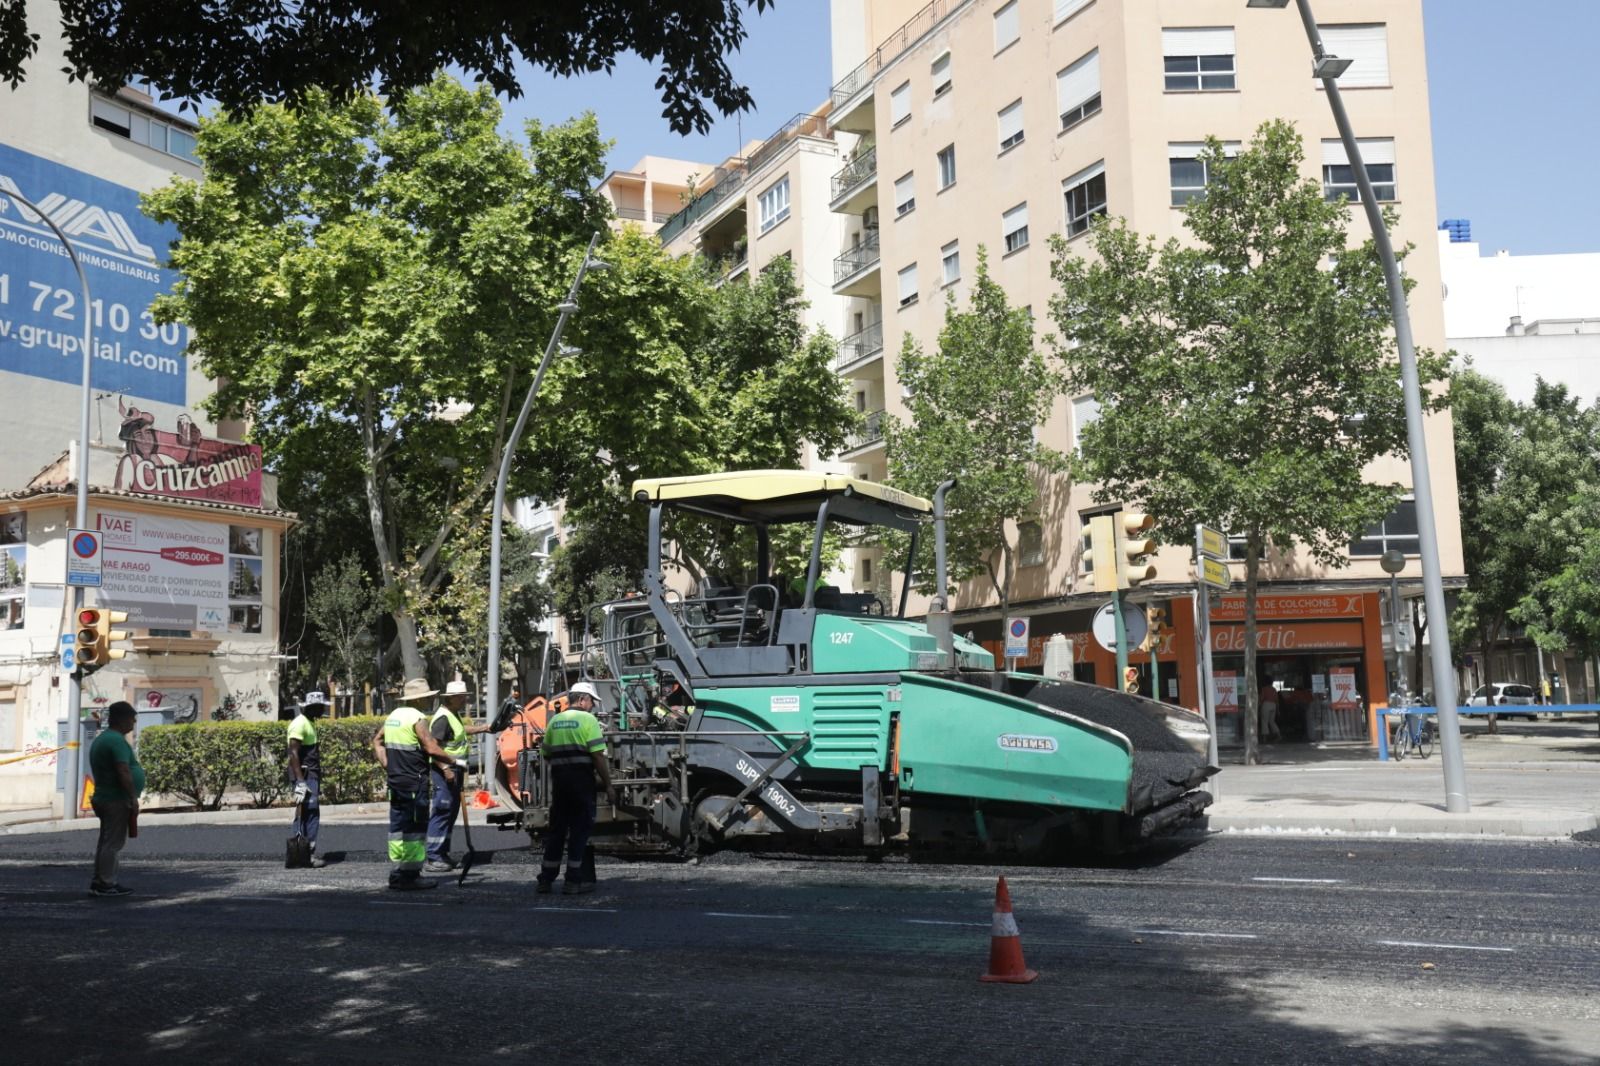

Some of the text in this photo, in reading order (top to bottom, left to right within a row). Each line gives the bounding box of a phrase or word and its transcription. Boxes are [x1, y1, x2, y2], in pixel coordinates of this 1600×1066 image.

[78, 252, 161, 284] INMOBILIARIAS
[29, 281, 75, 321] 72
[91, 298, 130, 333] 10
[136, 452, 259, 492] Cruzcampo
[104, 518, 132, 533] VAE
[142, 529, 225, 546] WWW.VAEHOMES.COM
[103, 560, 119, 570] VAE
[103, 572, 146, 583] VIVIENDAS
[148, 574, 162, 585] DE
[168, 577, 222, 590] DORMITORIOS
[103, 582, 224, 600] ZONA SOLARIUM CON JACUZZI
[1221, 598, 1337, 611] FABRA DE COLCHONES
[829, 631, 855, 644] 1247
[767, 787, 796, 817] 1900-2
